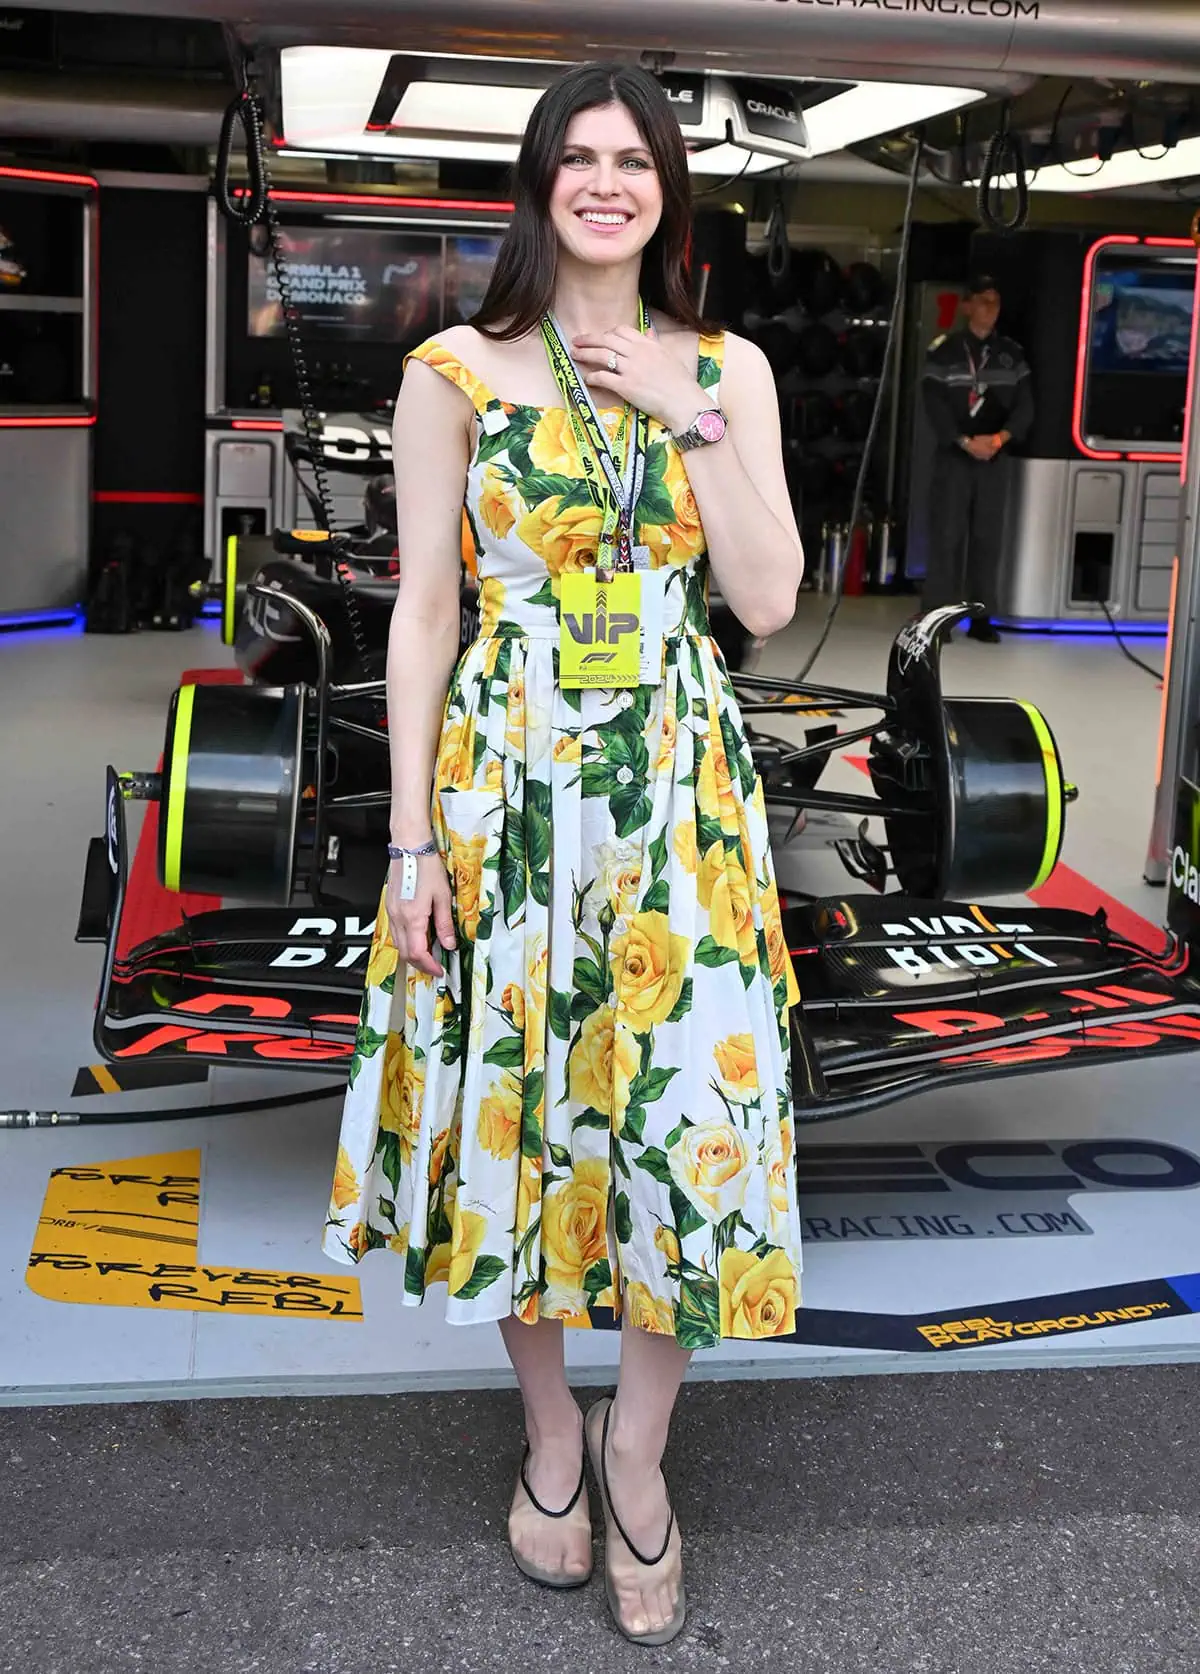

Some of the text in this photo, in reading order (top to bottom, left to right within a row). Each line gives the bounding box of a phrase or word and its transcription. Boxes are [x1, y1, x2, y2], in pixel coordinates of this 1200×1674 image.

[746, 99, 798, 124] ORACLE
[351, 265, 361, 278] 1
[290, 290, 367, 306] MONACO
[327, 279, 367, 293] PRIX
[554, 346, 580, 388] MONACO
[562, 613, 640, 645] VIP
[1172, 845, 1200, 906] Cla
